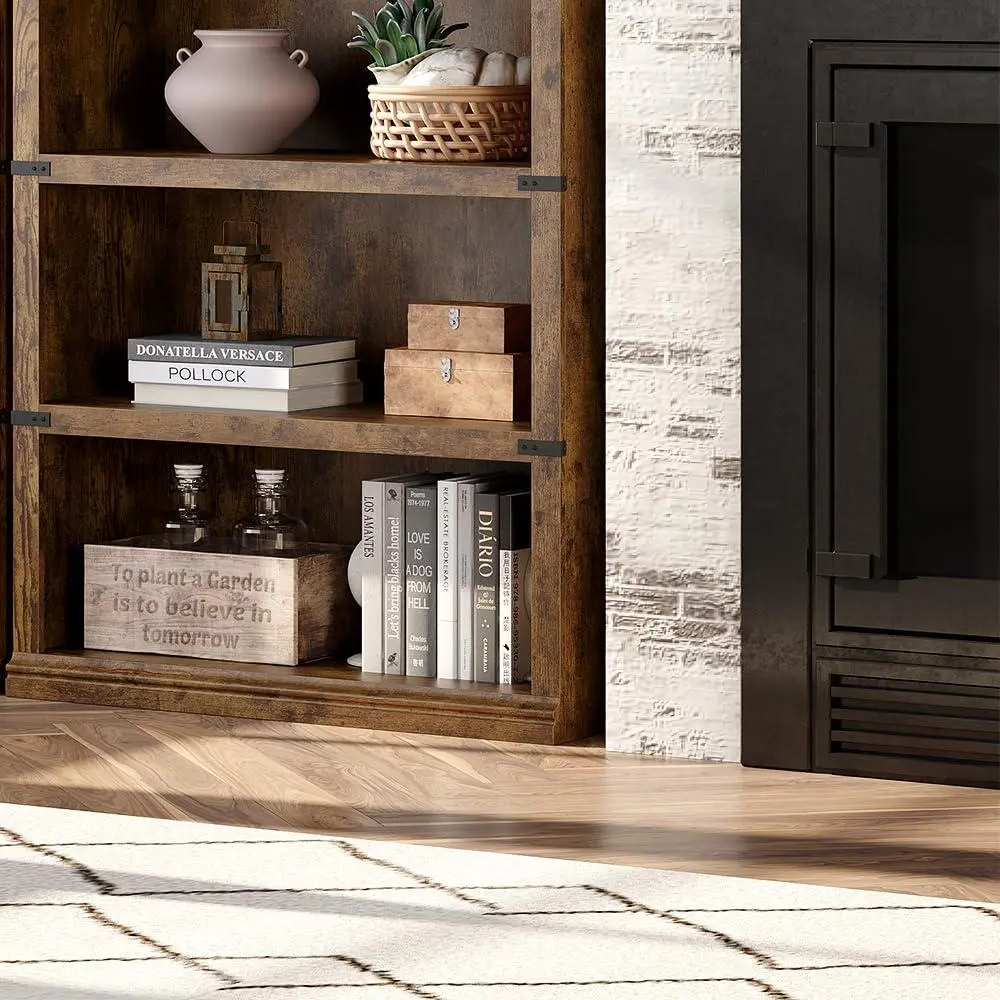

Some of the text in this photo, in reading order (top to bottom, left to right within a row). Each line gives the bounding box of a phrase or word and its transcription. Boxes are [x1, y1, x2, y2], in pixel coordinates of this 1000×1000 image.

[136, 344, 284, 362] DONATELLA VERSACE
[168, 367, 246, 383] POLLOCK
[364, 496, 374, 558] LOS AMANTES
[408, 532, 430, 544] LOVE
[478, 510, 496, 578] DIÁRIO
[413, 548, 423, 560] IS
[111, 563, 276, 593] To plant a Garden
[386, 516, 402, 639] Let's bring blacks home!
[406, 565, 433, 576] A DOG
[406, 580, 432, 594] FROM
[112, 592, 272, 623] is to believe in
[407, 598, 430, 610] HELL
[142, 623, 240, 649] tomorrow
